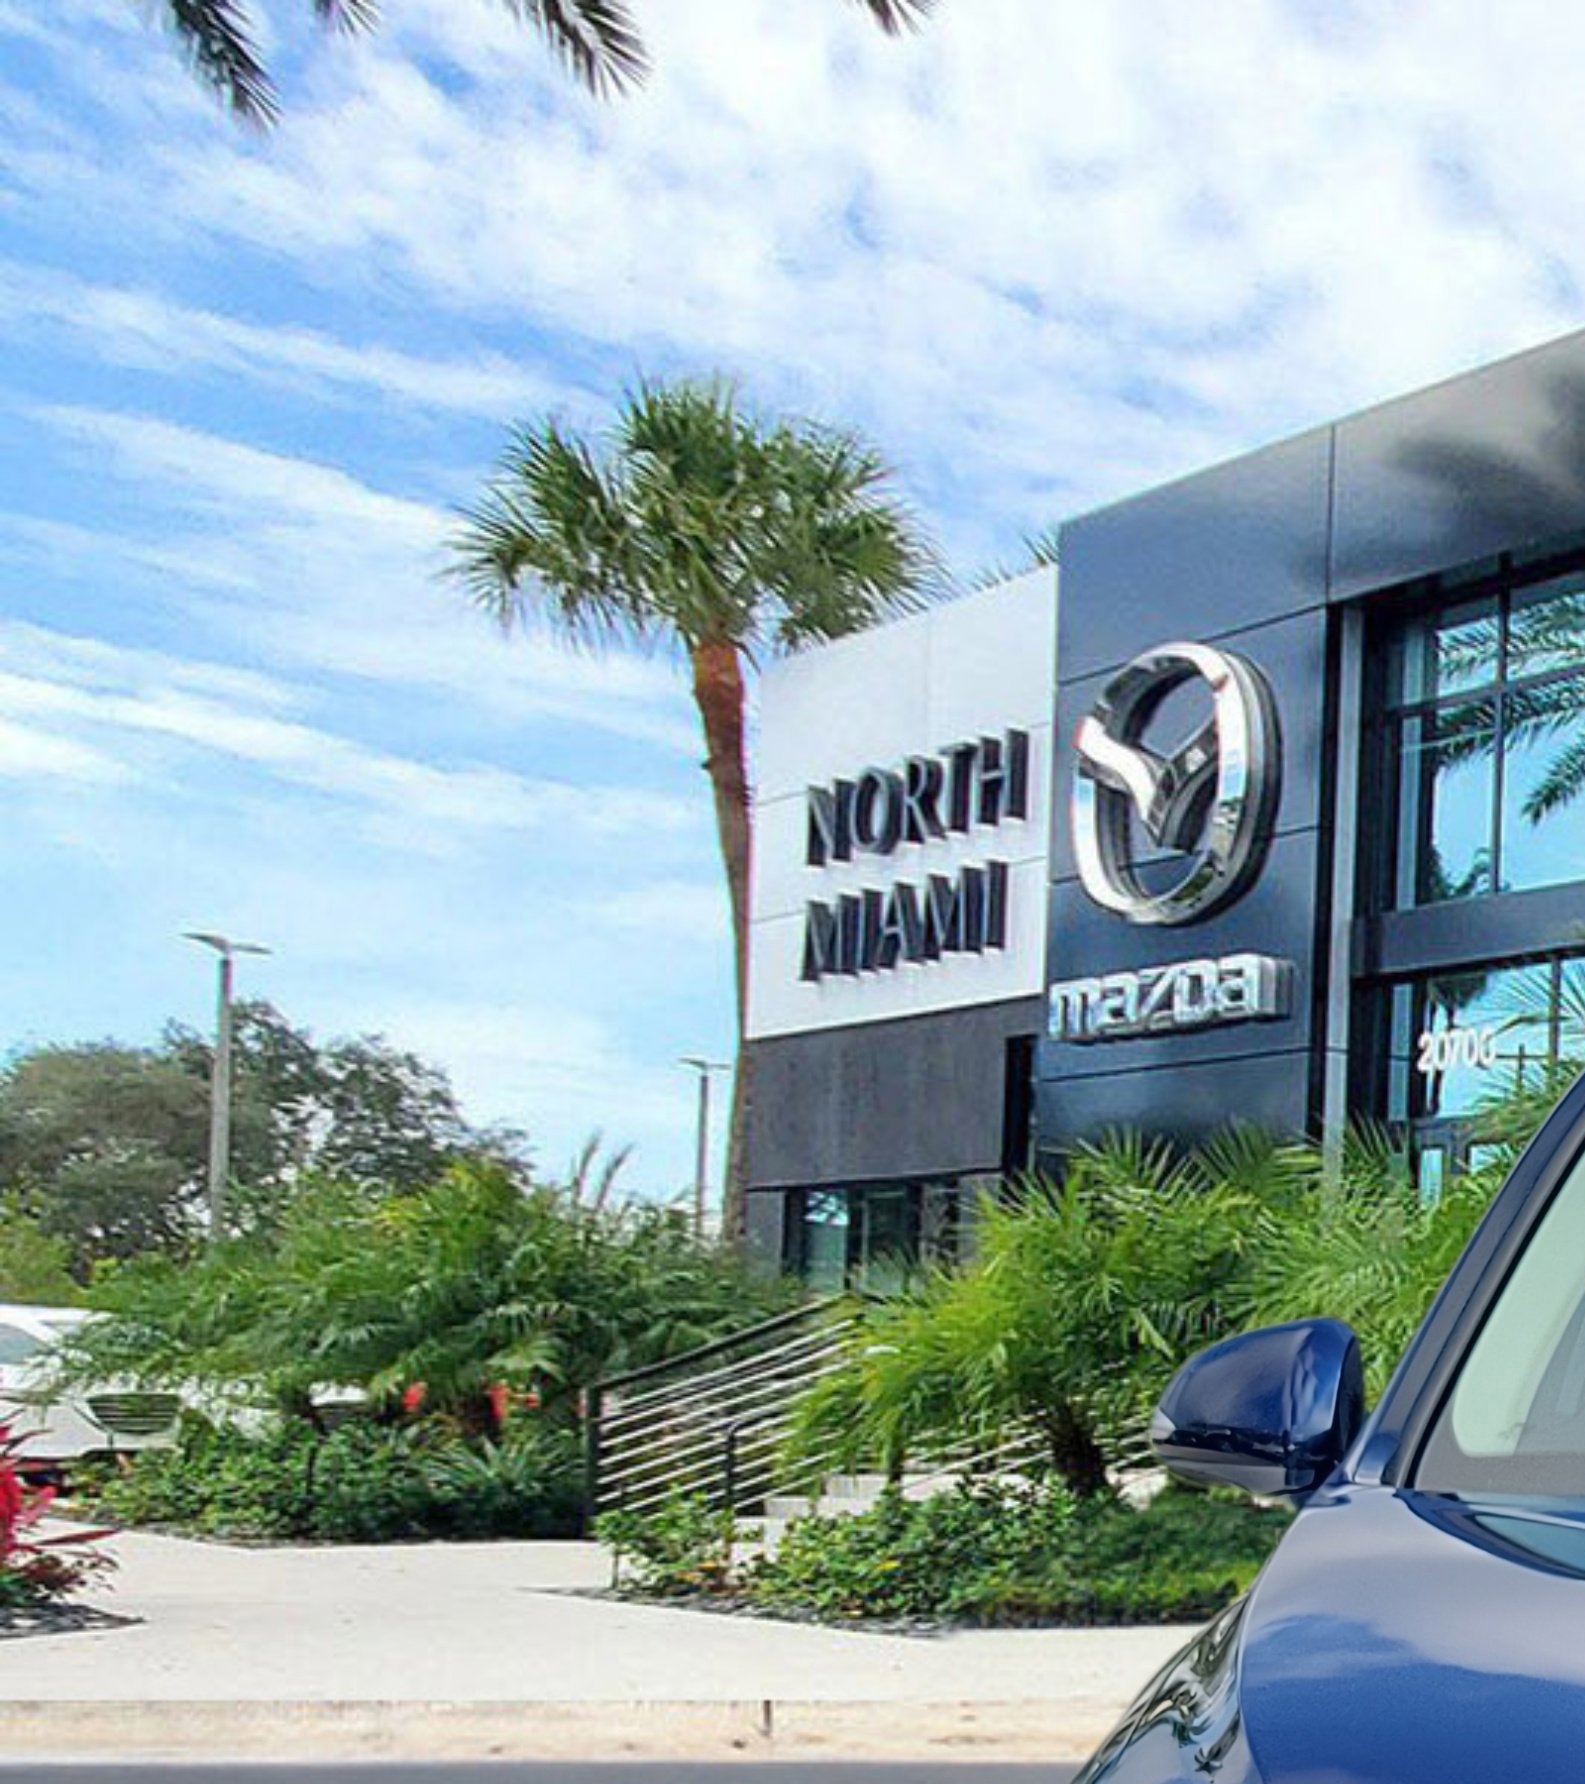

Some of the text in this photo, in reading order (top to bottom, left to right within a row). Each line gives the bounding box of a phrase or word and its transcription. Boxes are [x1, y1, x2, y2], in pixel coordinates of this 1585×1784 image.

[805, 727, 1029, 867] NORTH
[799, 858, 1008, 982] MIAMI
[1048, 953, 1278, 1040] mazda
